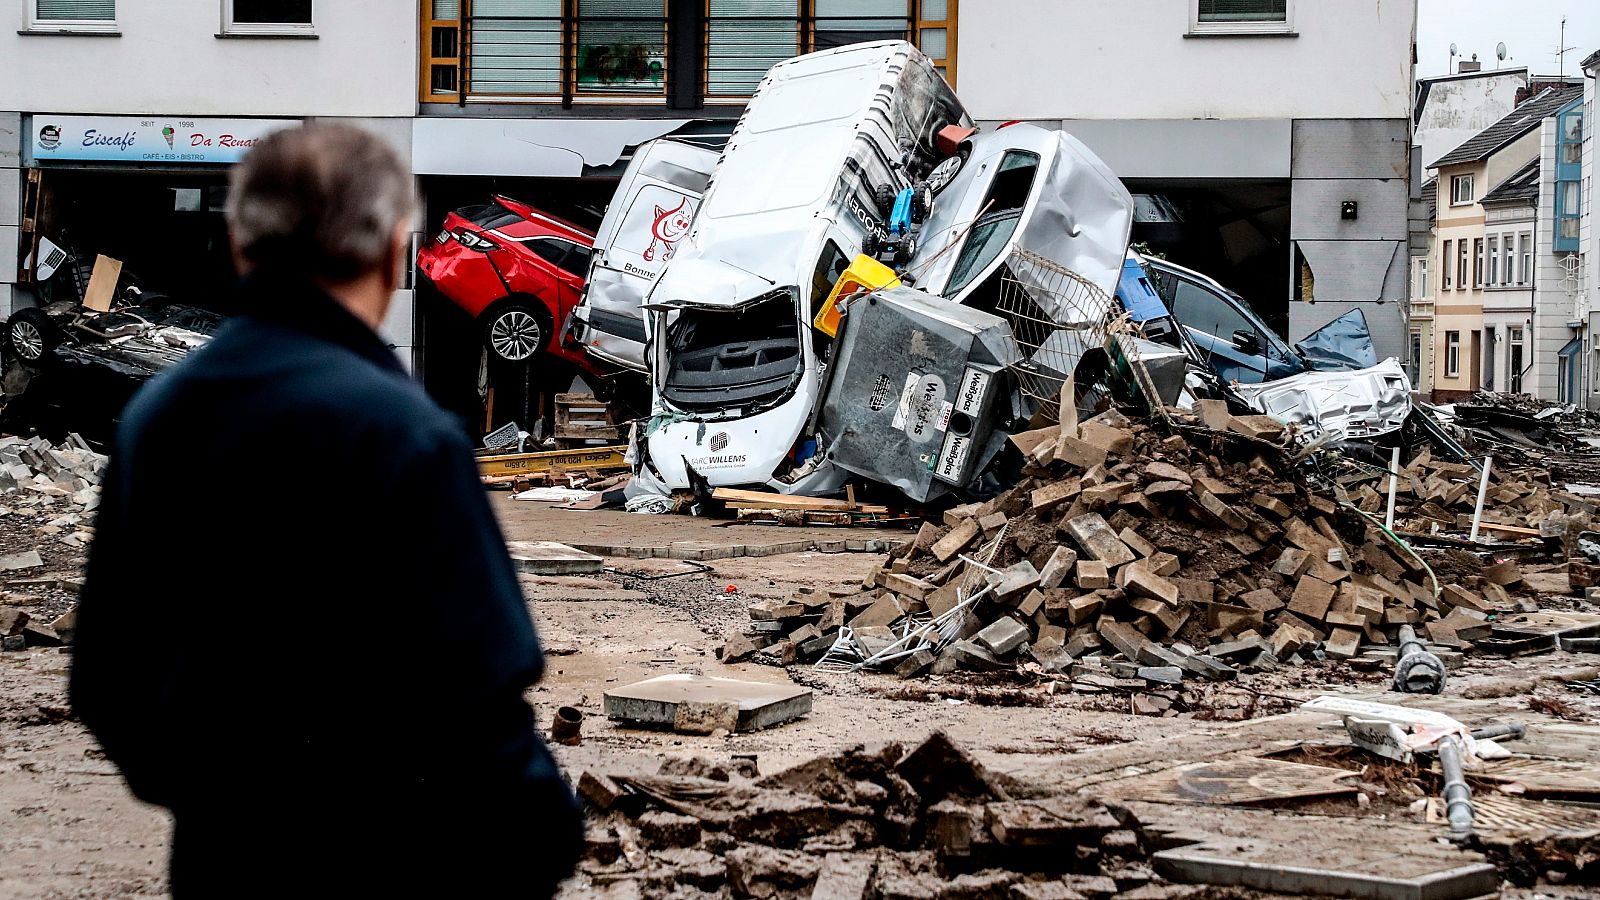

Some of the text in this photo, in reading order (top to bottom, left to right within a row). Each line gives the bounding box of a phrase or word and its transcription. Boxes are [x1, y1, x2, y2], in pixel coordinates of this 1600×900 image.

[82, 129, 136, 151] Eiscafé
[190, 133, 212, 147] Da
[963, 373, 981, 412] Weißglas
[944, 437, 962, 475] Weißglas
